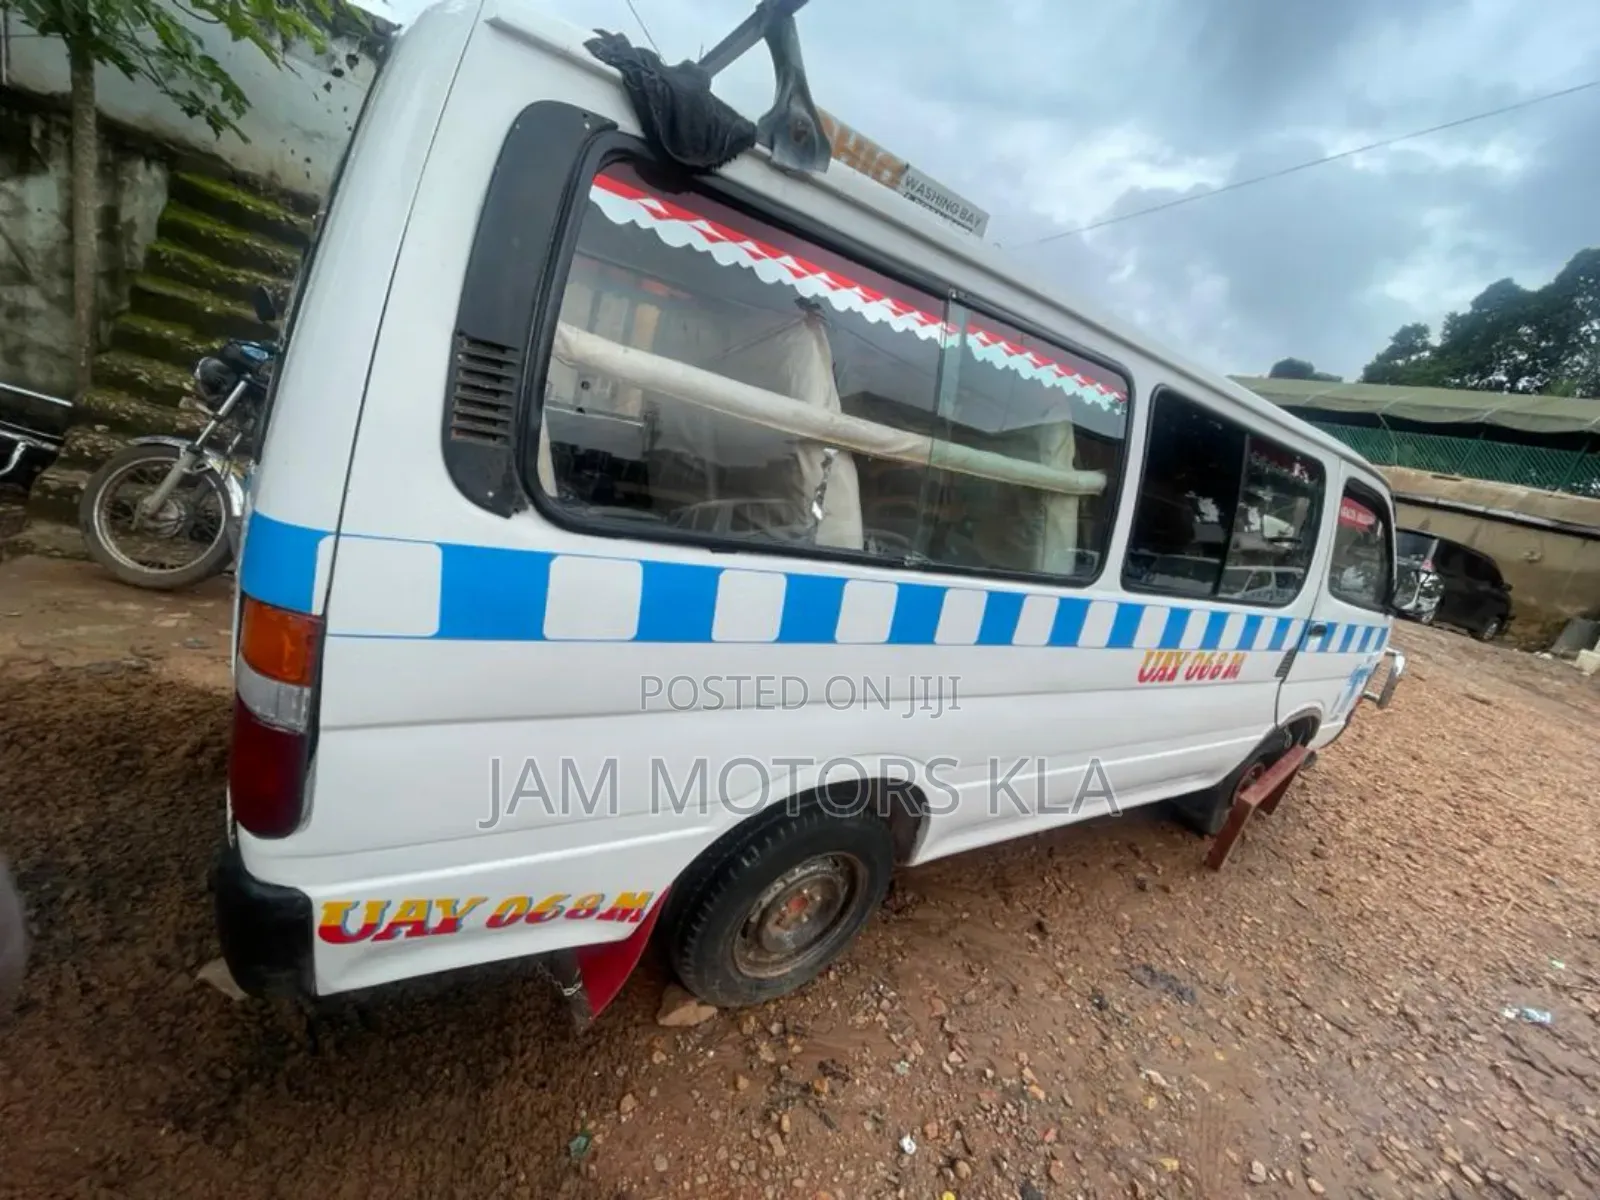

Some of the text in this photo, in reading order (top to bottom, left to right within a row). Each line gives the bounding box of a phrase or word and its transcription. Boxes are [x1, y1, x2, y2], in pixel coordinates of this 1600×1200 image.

[905, 174, 961, 215] WASHING
[960, 206, 983, 229] BAY
[1138, 649, 1191, 683] UAY
[318, 890, 654, 945] UAY 068M
